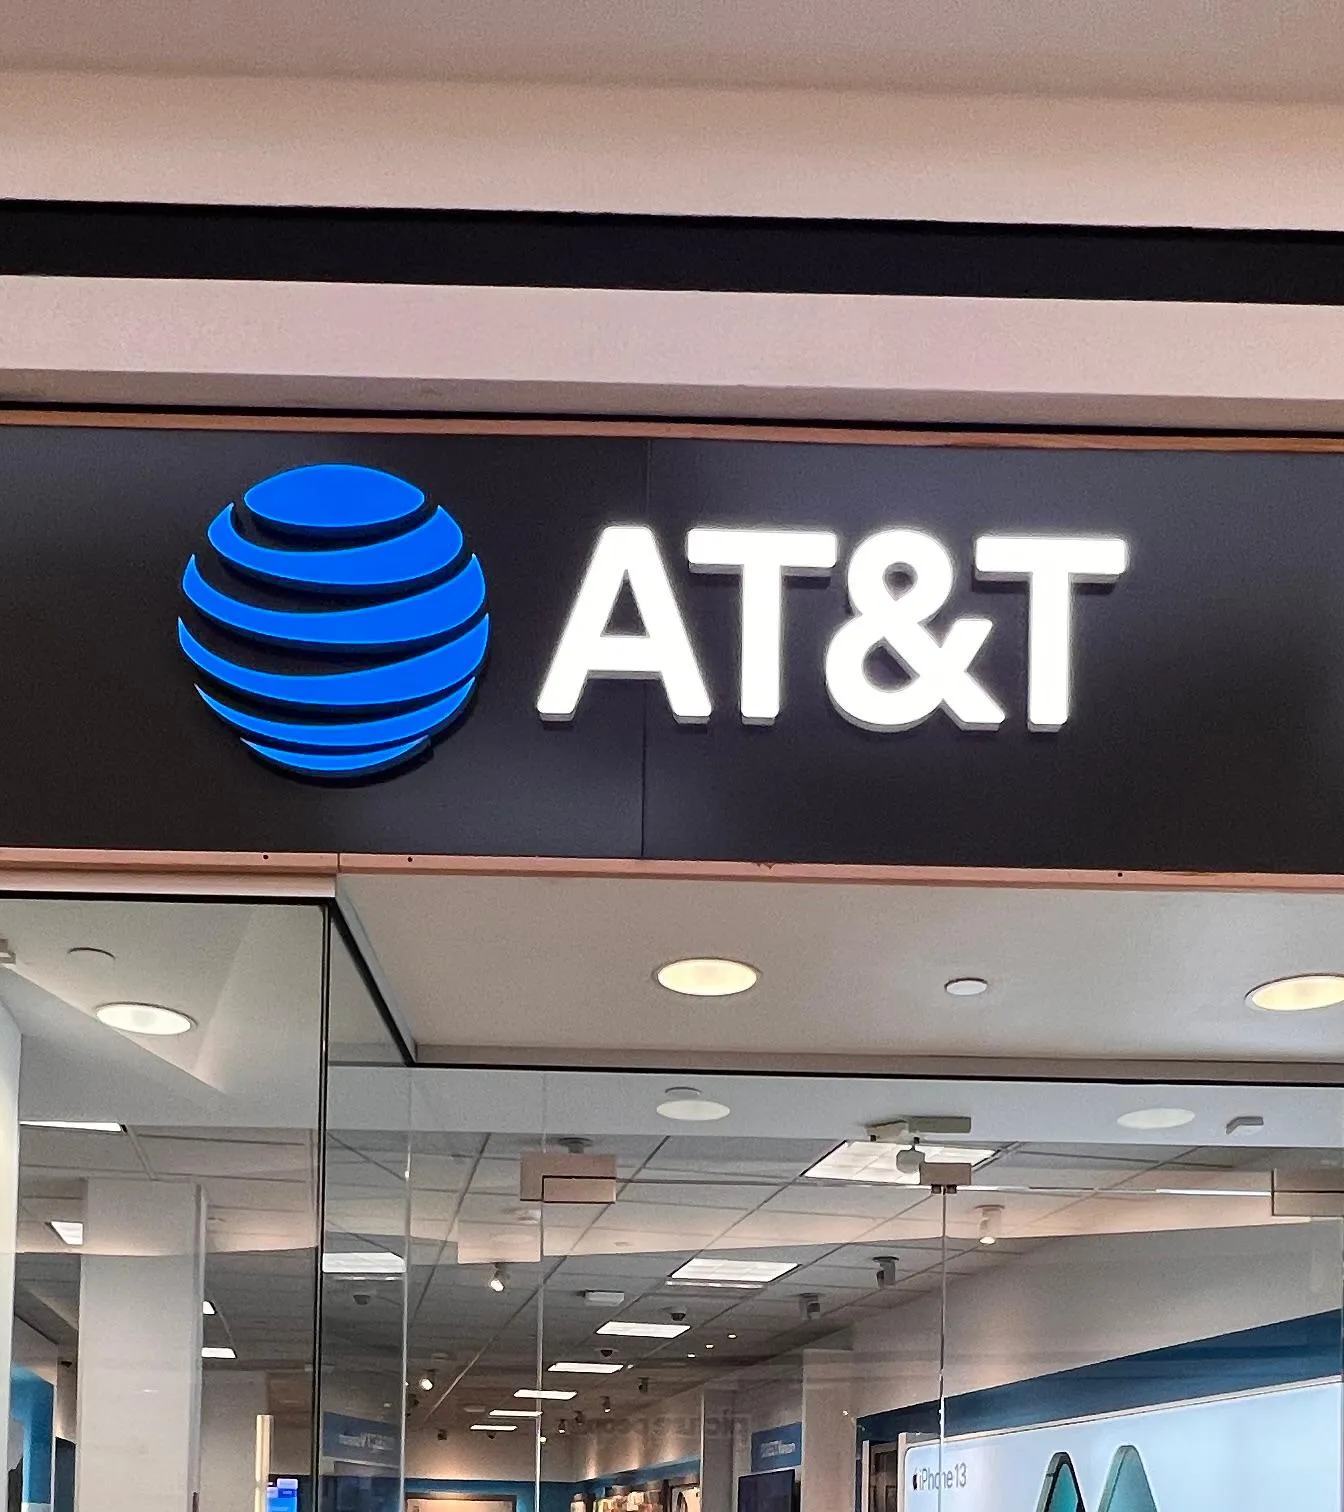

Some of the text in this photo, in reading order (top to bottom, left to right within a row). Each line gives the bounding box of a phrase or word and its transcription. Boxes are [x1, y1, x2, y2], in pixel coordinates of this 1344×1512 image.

[537, 525, 1129, 733] AT&T
[919, 1462, 967, 1491] iPhone 13
